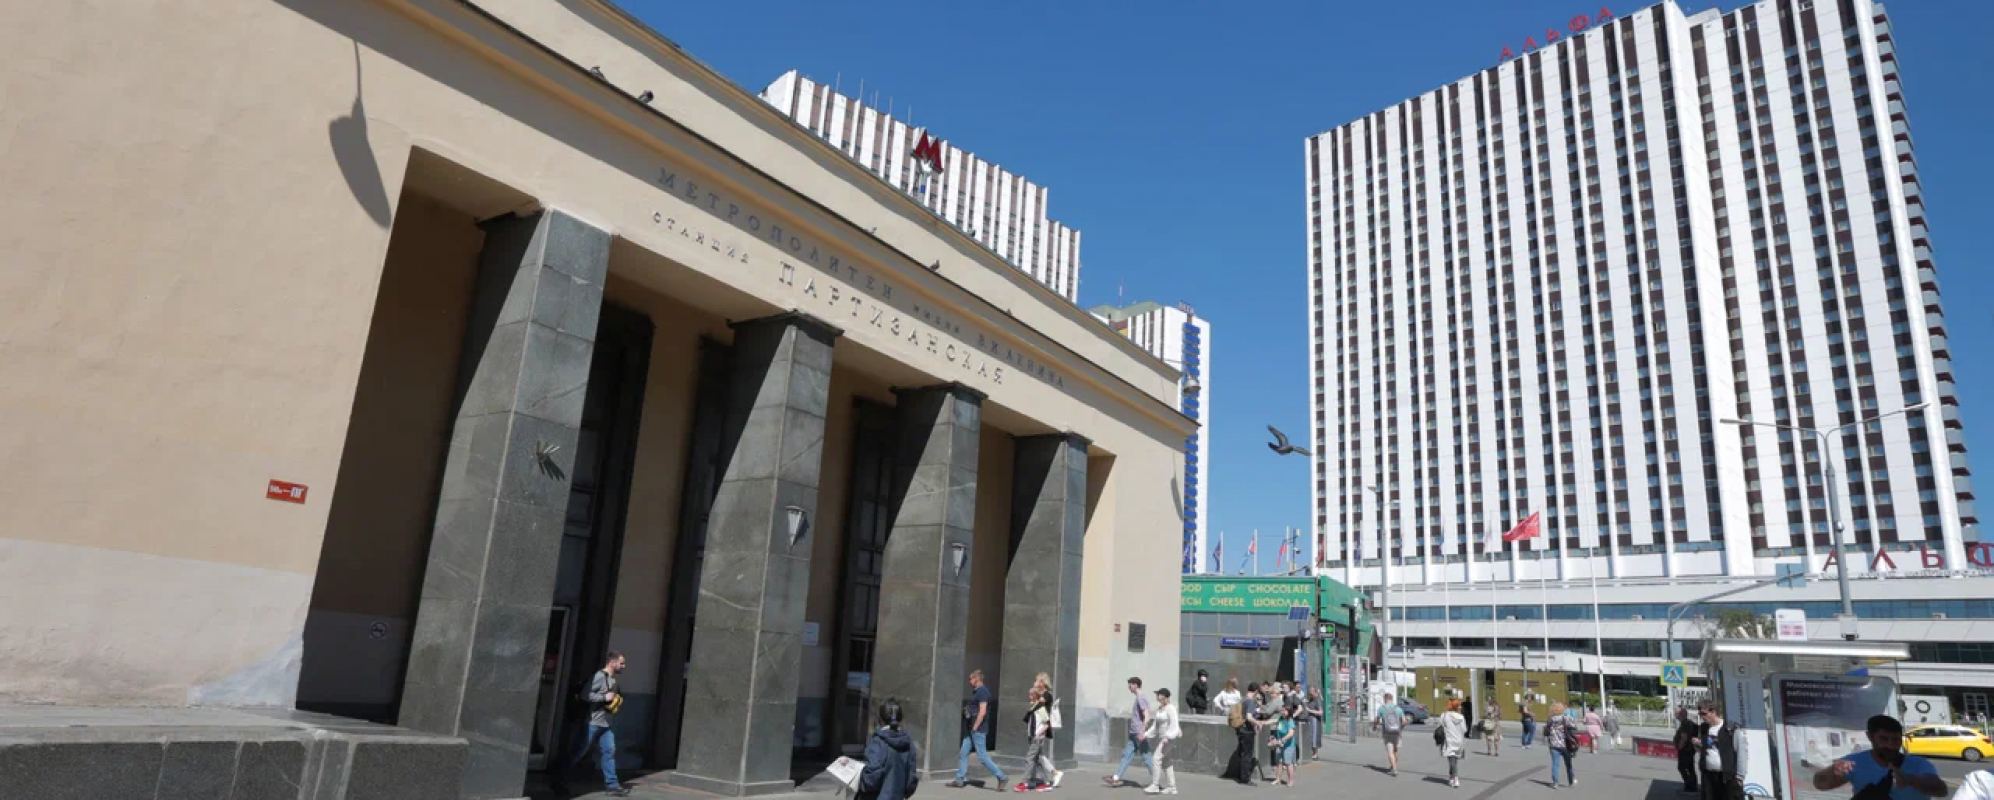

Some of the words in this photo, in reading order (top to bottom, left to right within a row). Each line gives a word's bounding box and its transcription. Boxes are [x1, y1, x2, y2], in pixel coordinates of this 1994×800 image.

[1499, 6, 1614, 62] АЛЬФА
[657, 166, 894, 300] МЕТРОПОЛИТЕН
[652, 211, 750, 264] СТАНЦИЯ
[779, 259, 1003, 385] ПАРТИЗАНСКАЯ
[1209, 597, 1245, 607] CHEESE
[1214, 583, 1236, 593] СЫР
[1248, 583, 1311, 594] CHOCOLATE
